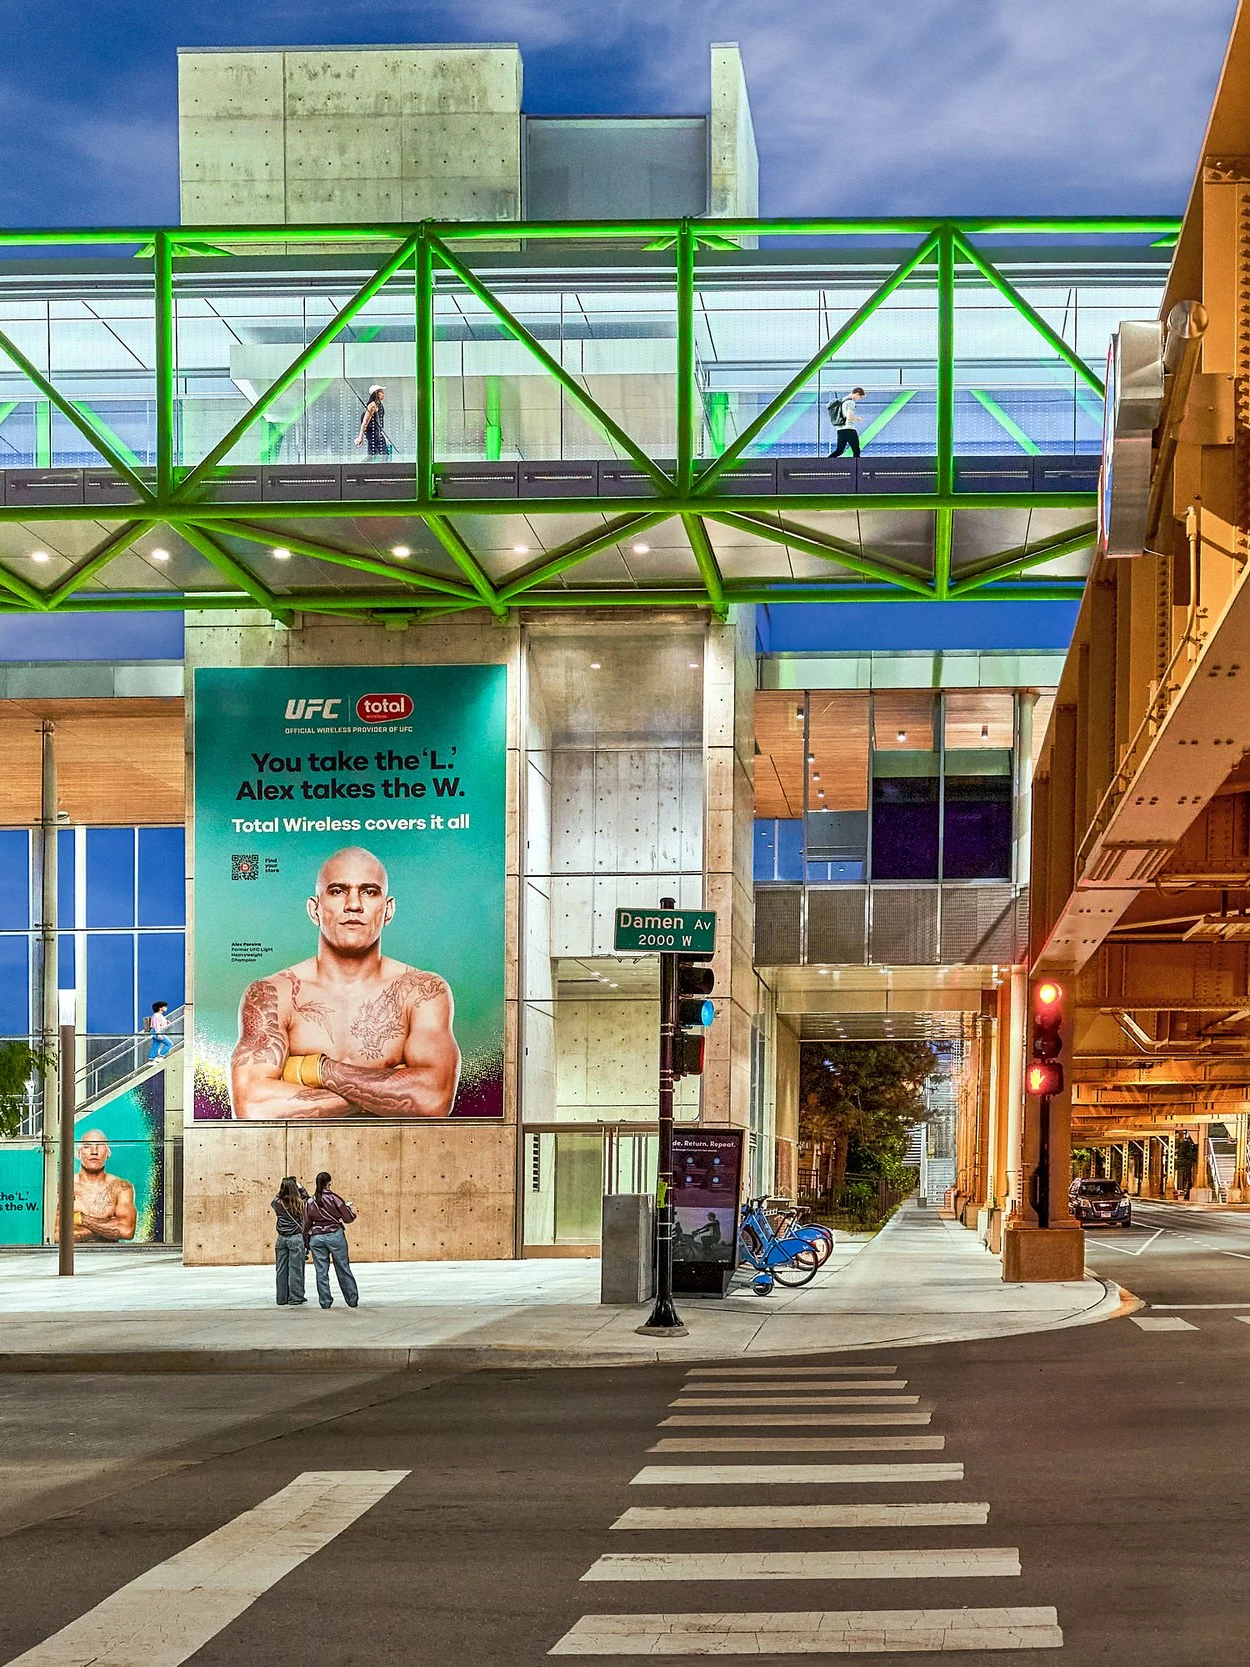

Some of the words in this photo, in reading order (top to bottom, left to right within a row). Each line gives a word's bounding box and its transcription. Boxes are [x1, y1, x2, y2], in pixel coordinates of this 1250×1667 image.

[284, 698, 342, 720] UFC
[363, 697, 405, 713] total
[251, 753, 302, 772] You
[308, 751, 369, 772] take
[375, 750, 419, 771] the
[236, 780, 295, 801] Alex
[300, 778, 376, 799] takes
[381, 778, 426, 798] the
[432, 777, 465, 797] W.
[231, 818, 279, 833] Total
[283, 816, 361, 832] Wireless
[364, 816, 426, 831] covers
[430, 814, 444, 830] it
[447, 813, 470, 829] all
[620, 912, 684, 930] Damen
[693, 919, 711, 930] Av
[638, 934, 675, 946] 2000
[681, 935, 692, 946] W
[710, 1141, 736, 1149] Repeat.
[5, 1202, 23, 1211] the
[25, 1202, 39, 1211] W.
